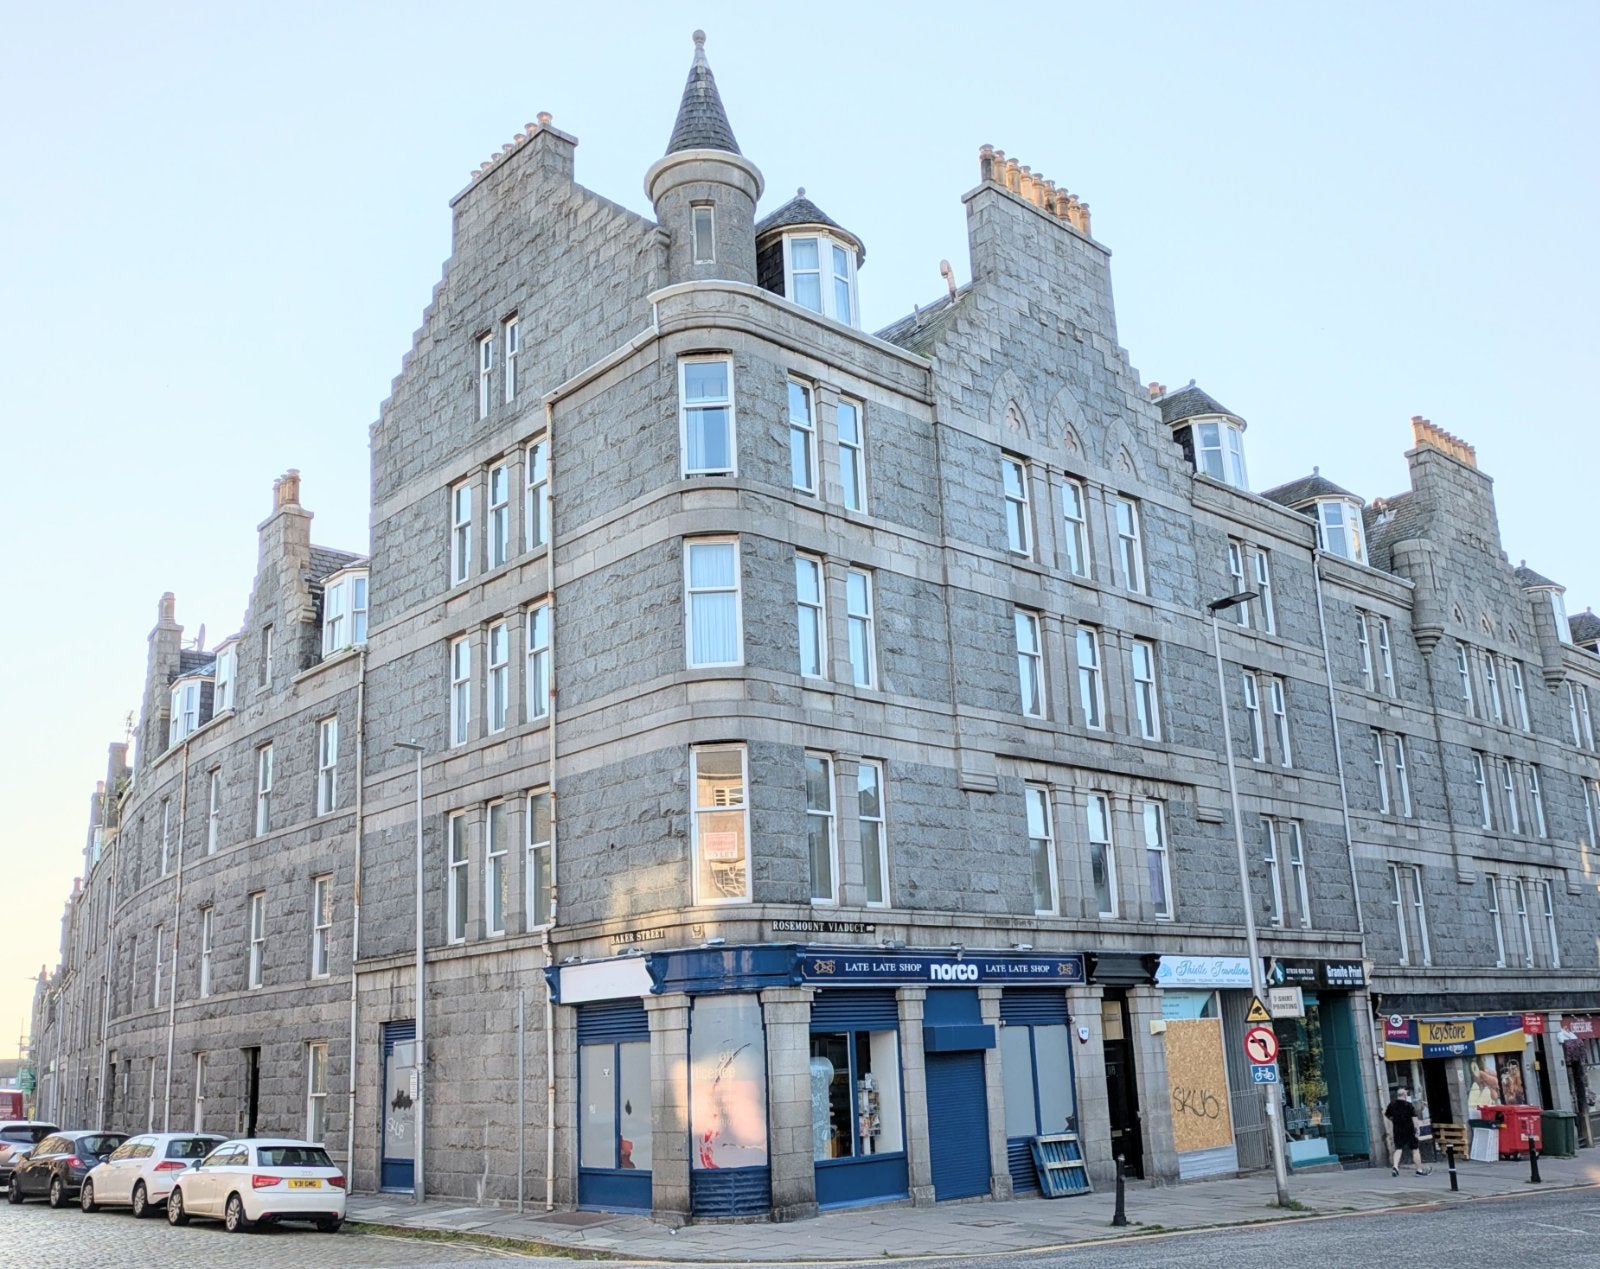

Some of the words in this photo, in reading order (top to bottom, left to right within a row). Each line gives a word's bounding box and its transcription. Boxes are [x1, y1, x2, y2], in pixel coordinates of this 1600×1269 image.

[772, 920, 825, 932] ROSEMOUNT
[828, 922, 865, 933] VIADUCT
[610, 932, 635, 945] BAKER
[636, 928, 665, 942] STREET
[845, 962, 869, 972] LATE
[872, 962, 897, 972] LATE
[899, 962, 922, 972] SHOP
[930, 963, 979, 981] norco
[985, 964, 1007, 973] LATE
[1008, 964, 1029, 973] LATE
[1030, 965, 1050, 974] SHOP
[1326, 964, 1348, 978] Granite
[1348, 965, 1363, 978] Print
